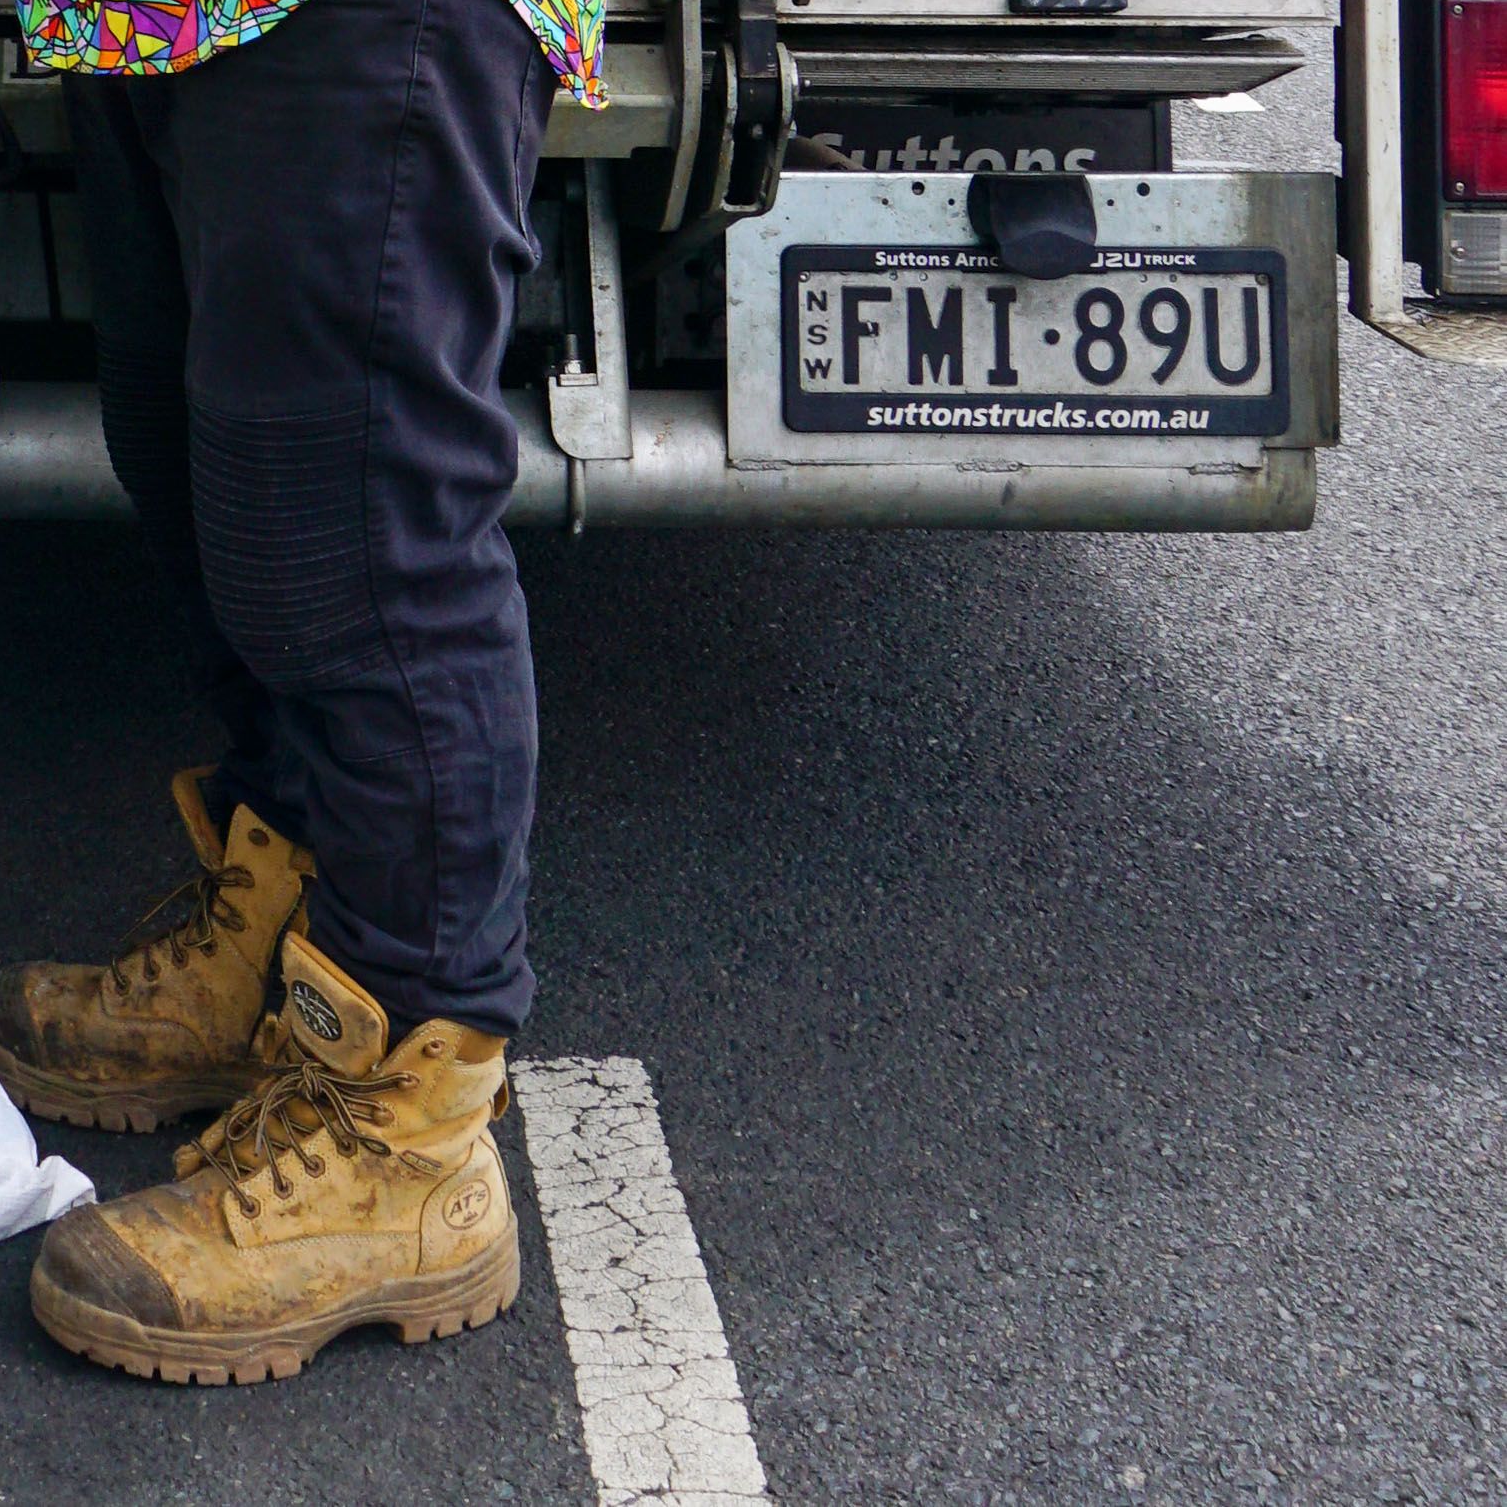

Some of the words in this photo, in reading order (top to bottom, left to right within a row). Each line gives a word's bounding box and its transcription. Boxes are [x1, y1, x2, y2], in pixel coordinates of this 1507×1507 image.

[875, 251, 951, 267] Suttons
[1144, 253, 1197, 266] TRUCK
[804, 292, 832, 381] NSW
[867, 402, 1210, 430] suttonstrucks.com.au
